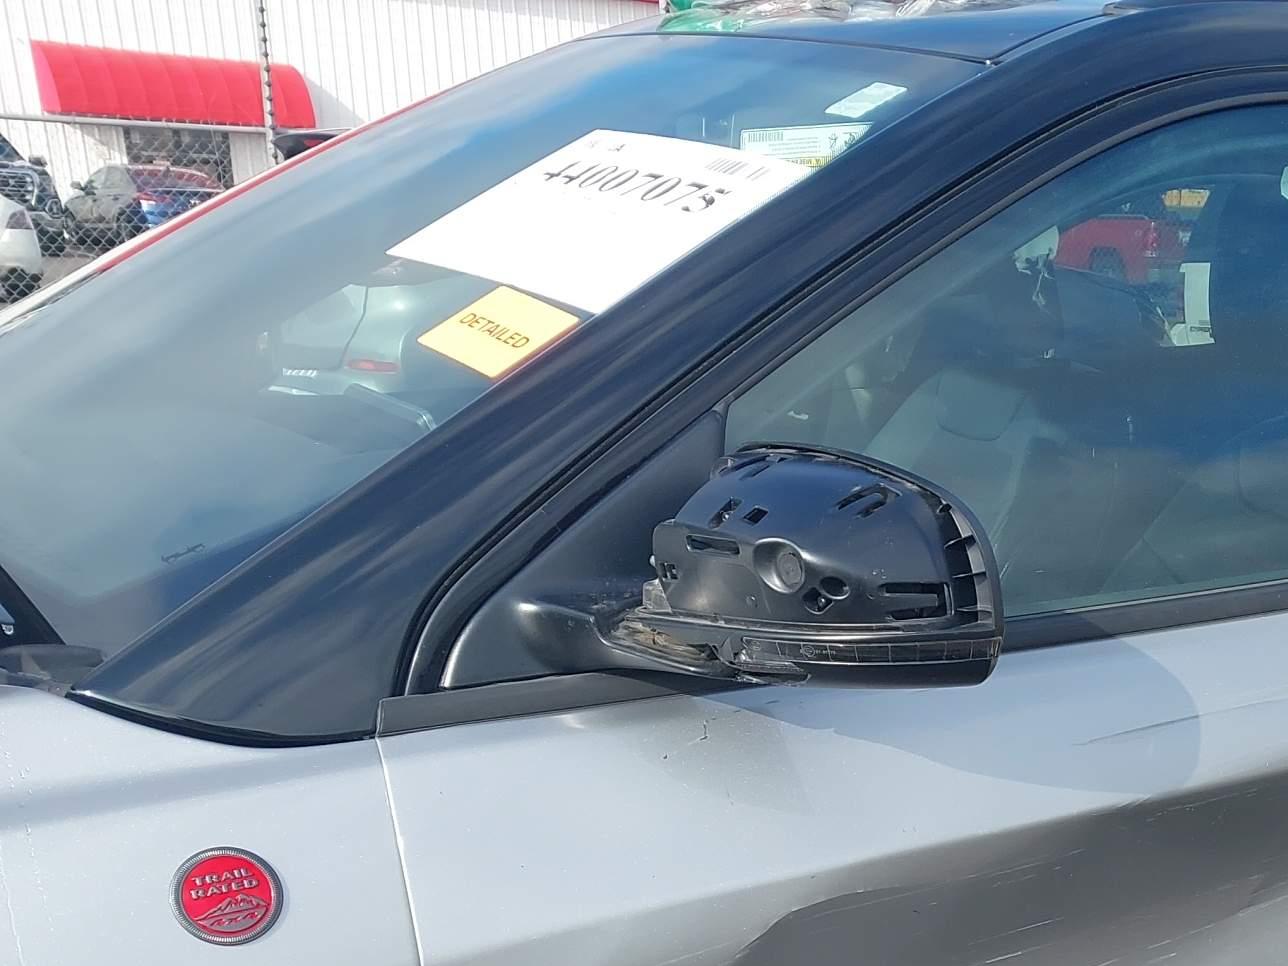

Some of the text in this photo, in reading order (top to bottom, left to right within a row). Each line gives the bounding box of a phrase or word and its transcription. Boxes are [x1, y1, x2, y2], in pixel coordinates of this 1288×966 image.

[543, 160, 733, 213] 44007075
[459, 312, 530, 349] DETAILED
[190, 879, 259, 900] RATED
[191, 867, 254, 886] TRAIL
